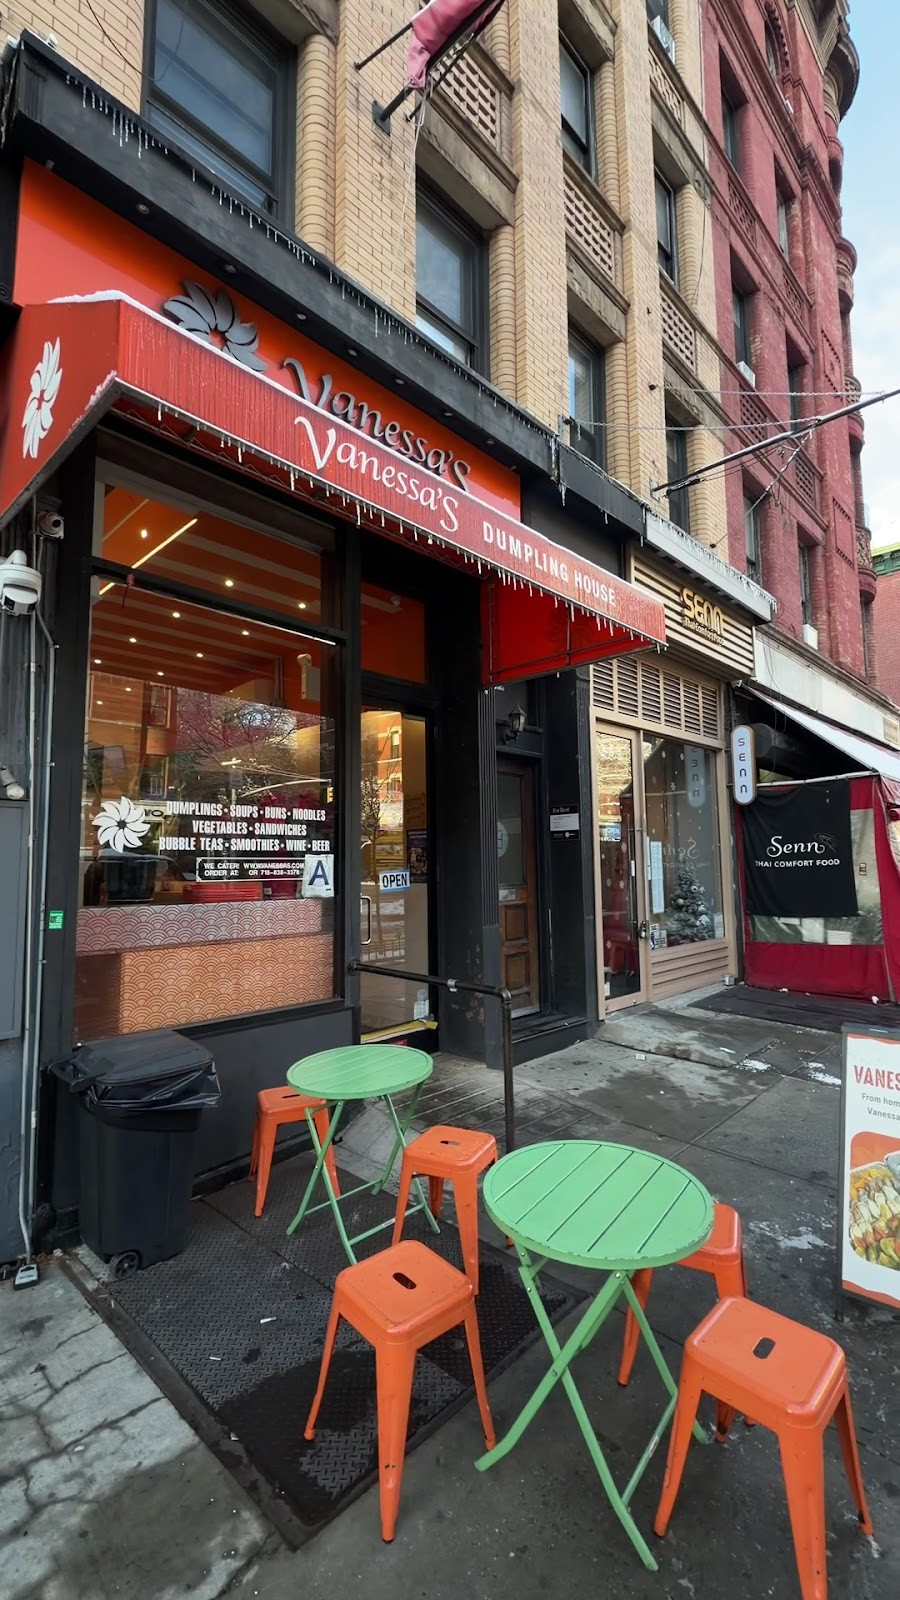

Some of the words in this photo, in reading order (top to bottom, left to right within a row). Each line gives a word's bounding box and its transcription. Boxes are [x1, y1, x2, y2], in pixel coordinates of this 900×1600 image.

[482, 521, 568, 581] DUMPLING
[574, 569, 616, 606] HOUSE
[166, 801, 223, 816] DUMPLINGS
[230, 804, 258, 818] SOUPS
[265, 806, 286, 820] BUNS
[292, 808, 326, 821] NOODLES
[192, 820, 247, 834] VEGETABLES
[254, 823, 307, 836] SANDWICHES
[159, 837, 196, 850] BUBBLE
[200, 838, 223, 850] TEAS
[230, 838, 280, 851] SMOOTHIES
[286, 840, 306, 851] WINE
[312, 841, 330, 851] BEER
[766, 836, 825, 857] Senn
[308, 860, 329, 885] A
[382, 873, 407, 888] OPEN
[862, 1093, 881, 1103] From
